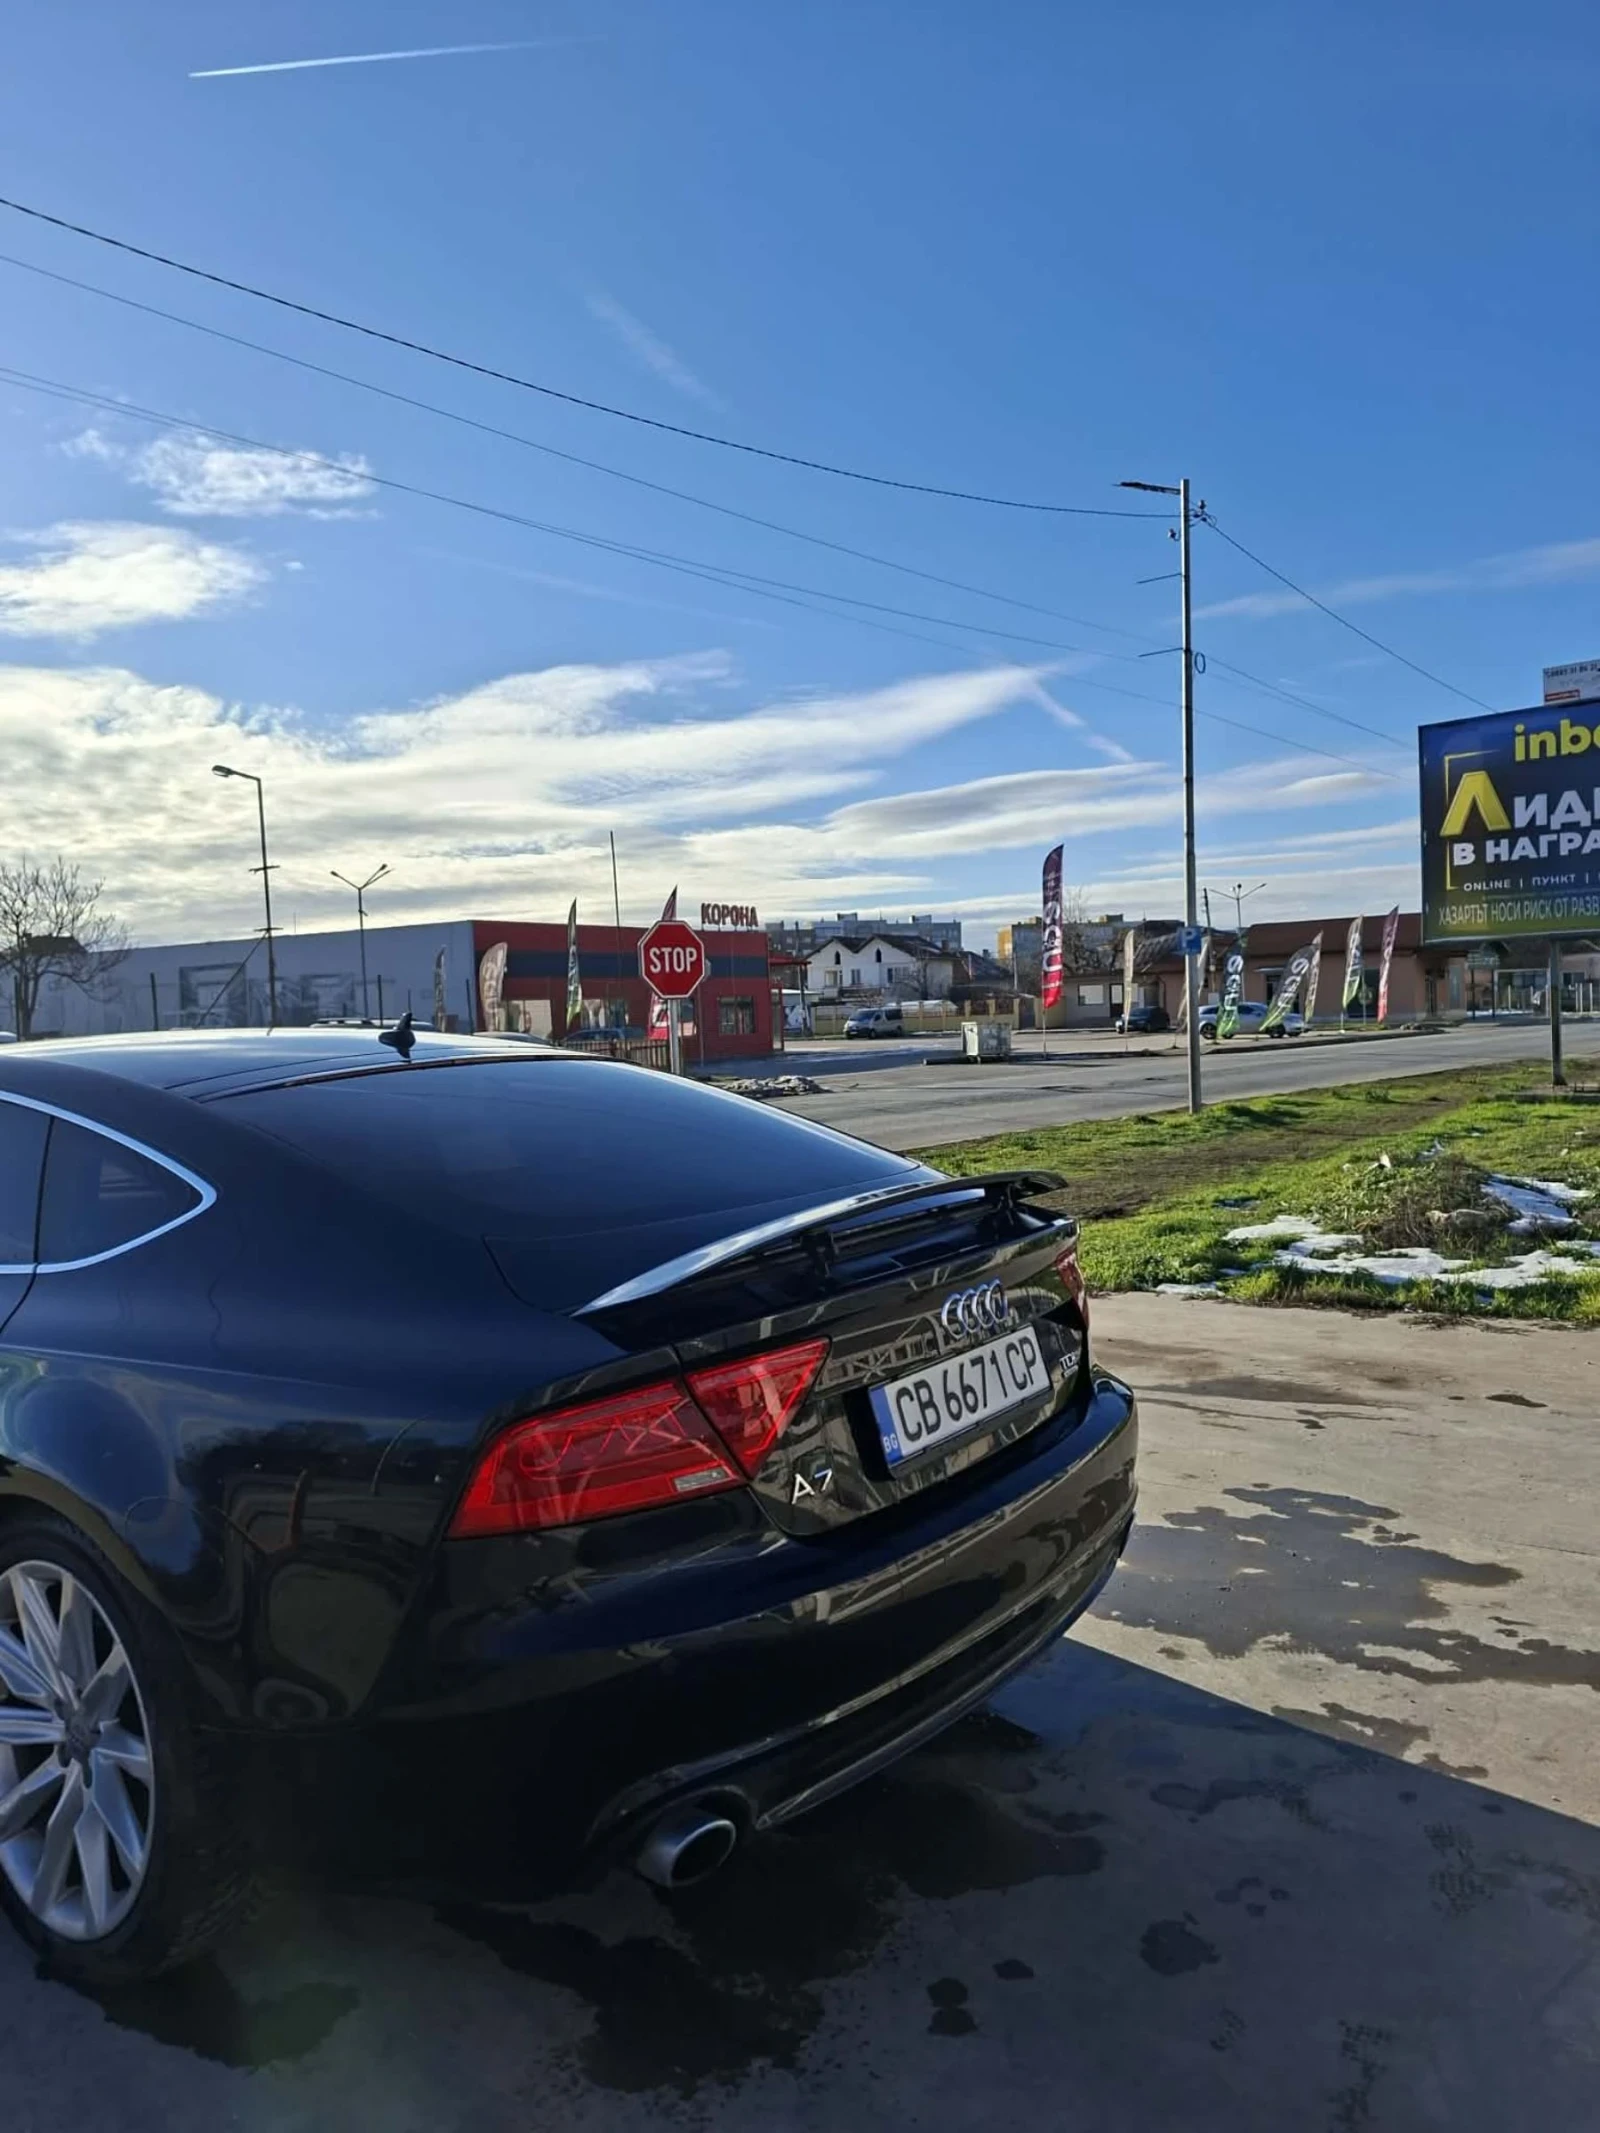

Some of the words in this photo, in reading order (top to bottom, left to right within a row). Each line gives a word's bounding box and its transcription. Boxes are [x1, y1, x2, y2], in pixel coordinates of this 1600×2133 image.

[1514, 718, 1600, 762] inb
[1453, 842, 1476, 866] В
[1463, 878, 1511, 892] ONLINE
[1532, 873, 1575, 886] ПУНКТ
[700, 902, 758, 927] КОРОНА
[1438, 902, 1488, 927] ХАЗАРТЪТ
[1491, 899, 1521, 923] НОСИ
[1524, 898, 1553, 920] РИСК
[1554, 896, 1569, 918] ОТ
[649, 946, 697, 974] STOP
[882, 1433, 899, 1451] BG
[791, 1469, 834, 1505] A7
